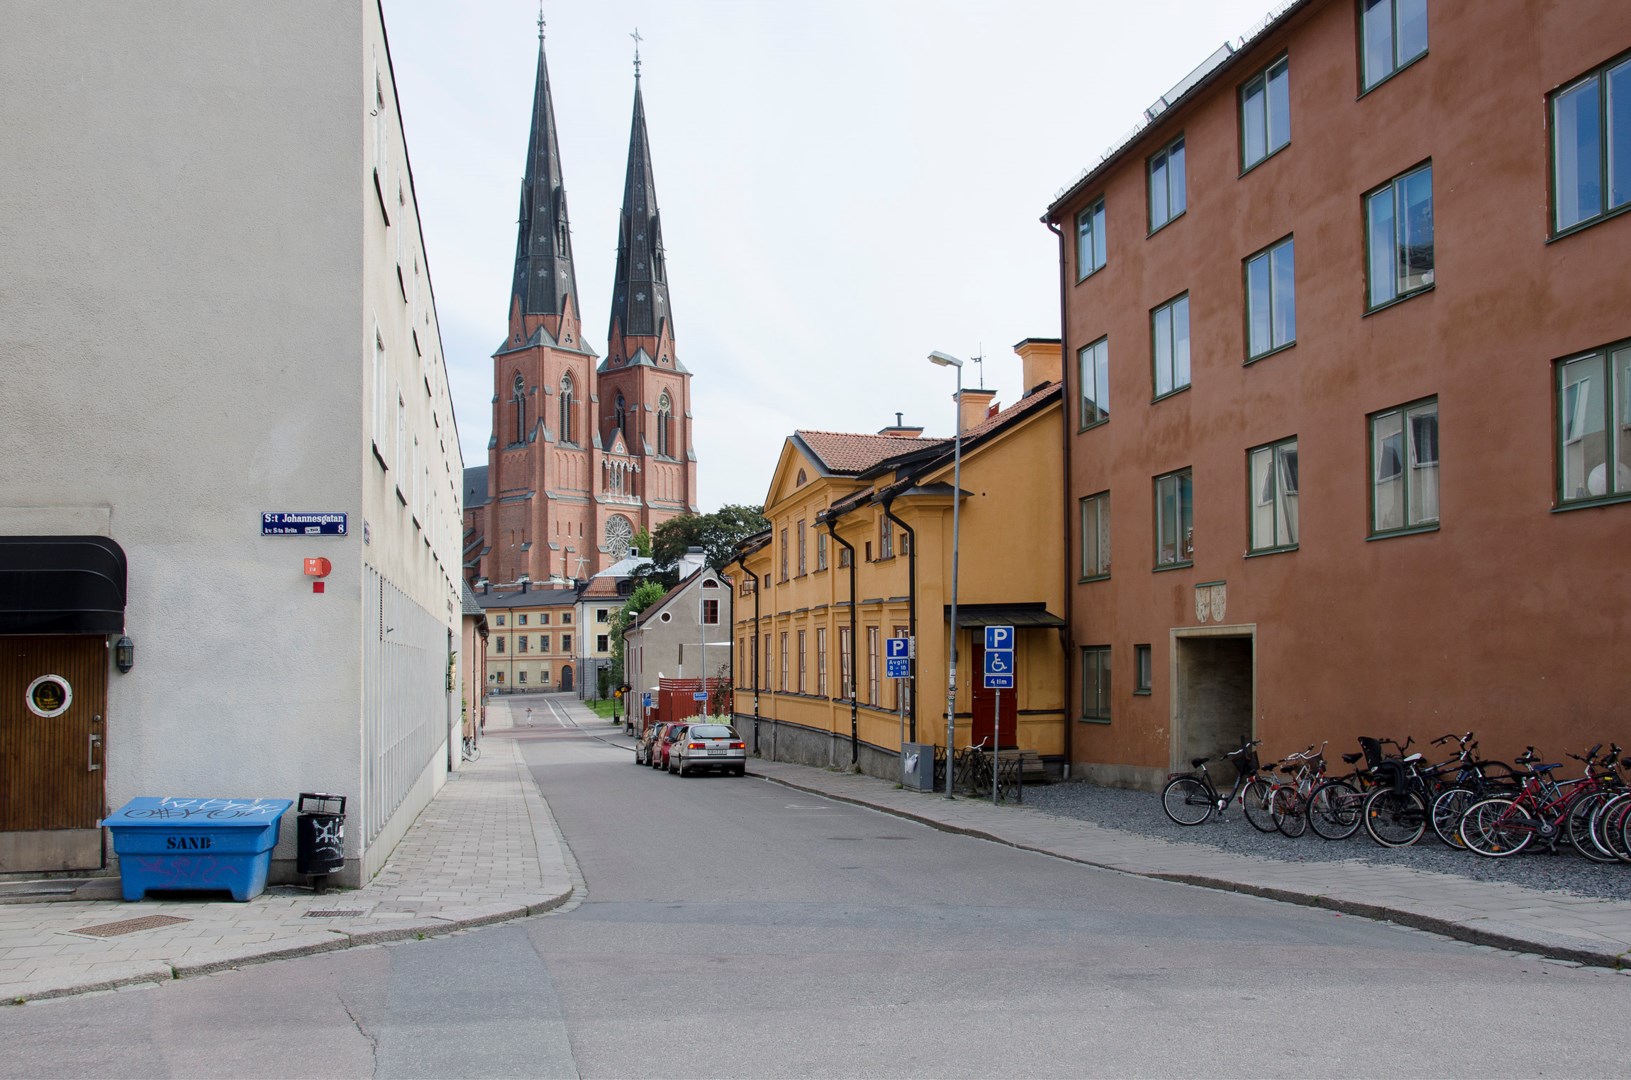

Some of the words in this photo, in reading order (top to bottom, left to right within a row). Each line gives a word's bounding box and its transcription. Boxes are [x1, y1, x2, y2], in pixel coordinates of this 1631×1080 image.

[265, 514, 278, 523] S:t
[282, 514, 344, 525] Johannesgatan
[338, 525, 344, 533] 8
[994, 629, 1008, 648] P
[892, 641, 904, 656] P
[166, 837, 211, 849] SAND
